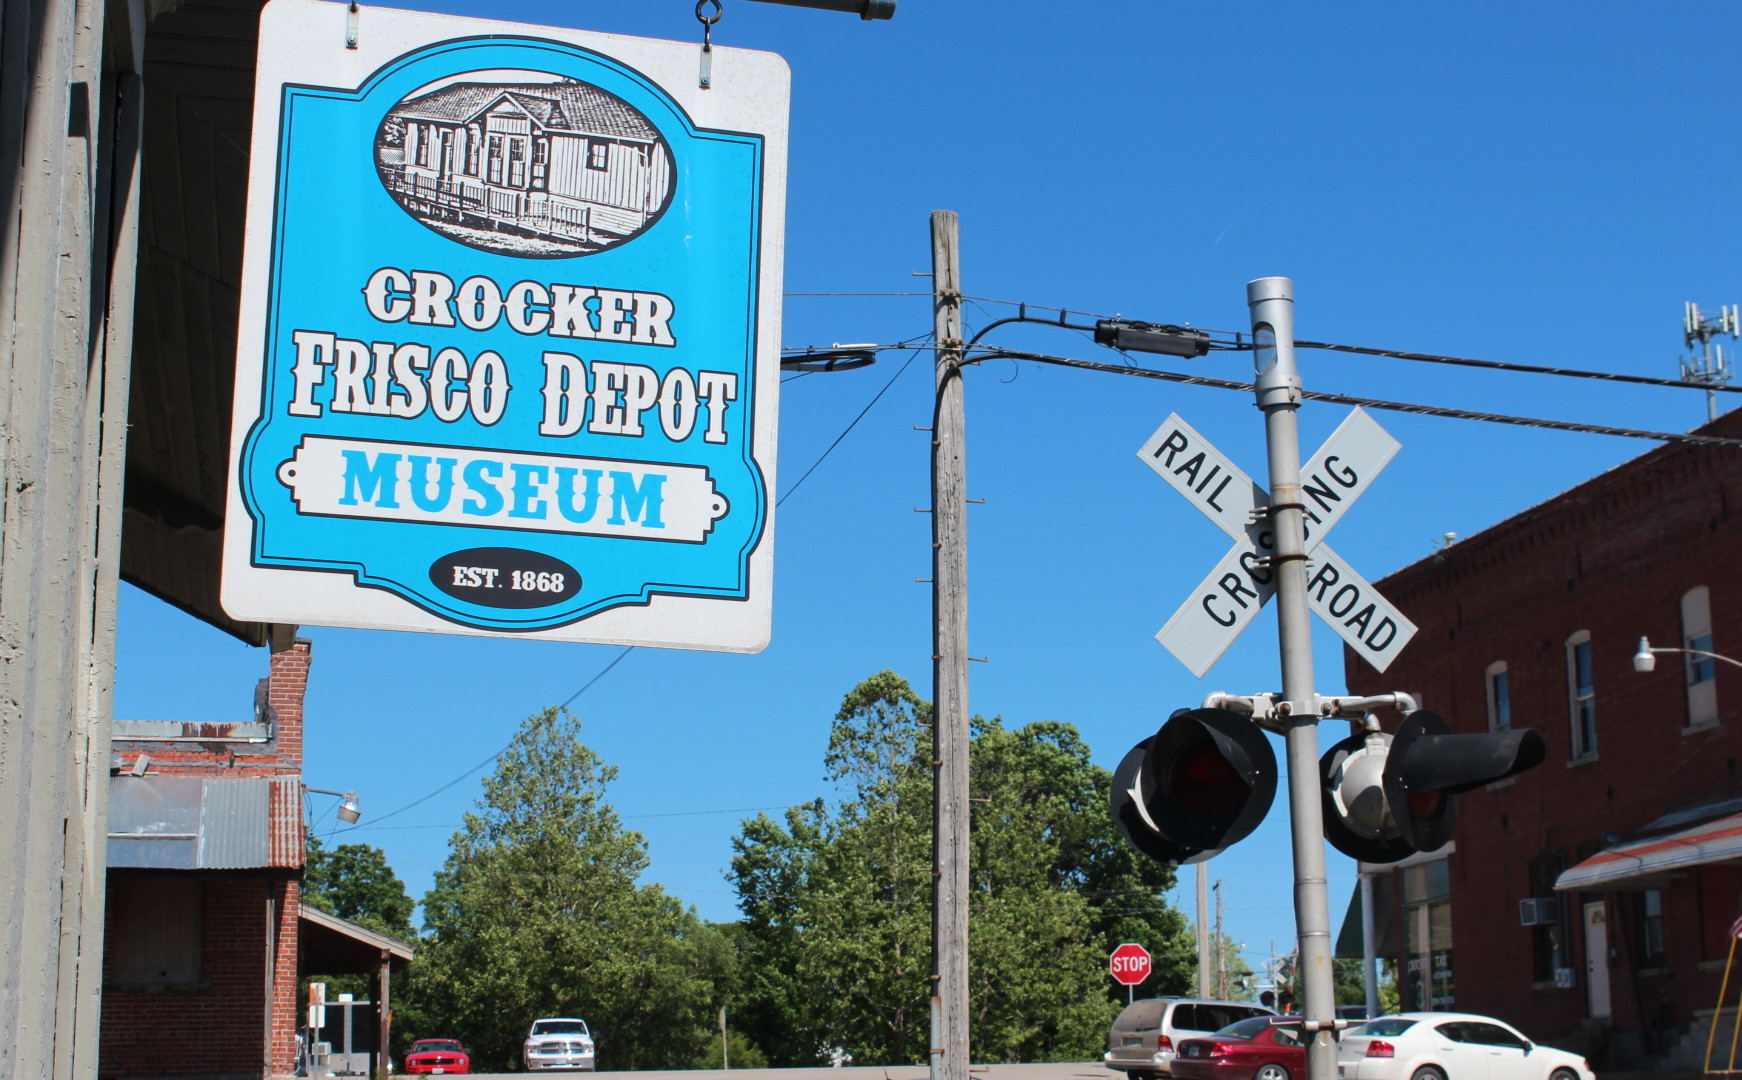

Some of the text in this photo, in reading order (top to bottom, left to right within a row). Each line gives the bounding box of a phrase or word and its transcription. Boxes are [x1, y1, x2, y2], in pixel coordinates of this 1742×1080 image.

[361, 267, 676, 347] CROCKER
[287, 330, 738, 444] FRISCO DEPOT
[338, 450, 668, 529] MUSEUM
[453, 566, 565, 593] EST. 1868
[1154, 429, 1397, 652] RAIL ROAD
[1202, 455, 1358, 627] CROING
[1113, 956, 1148, 972] STOP
